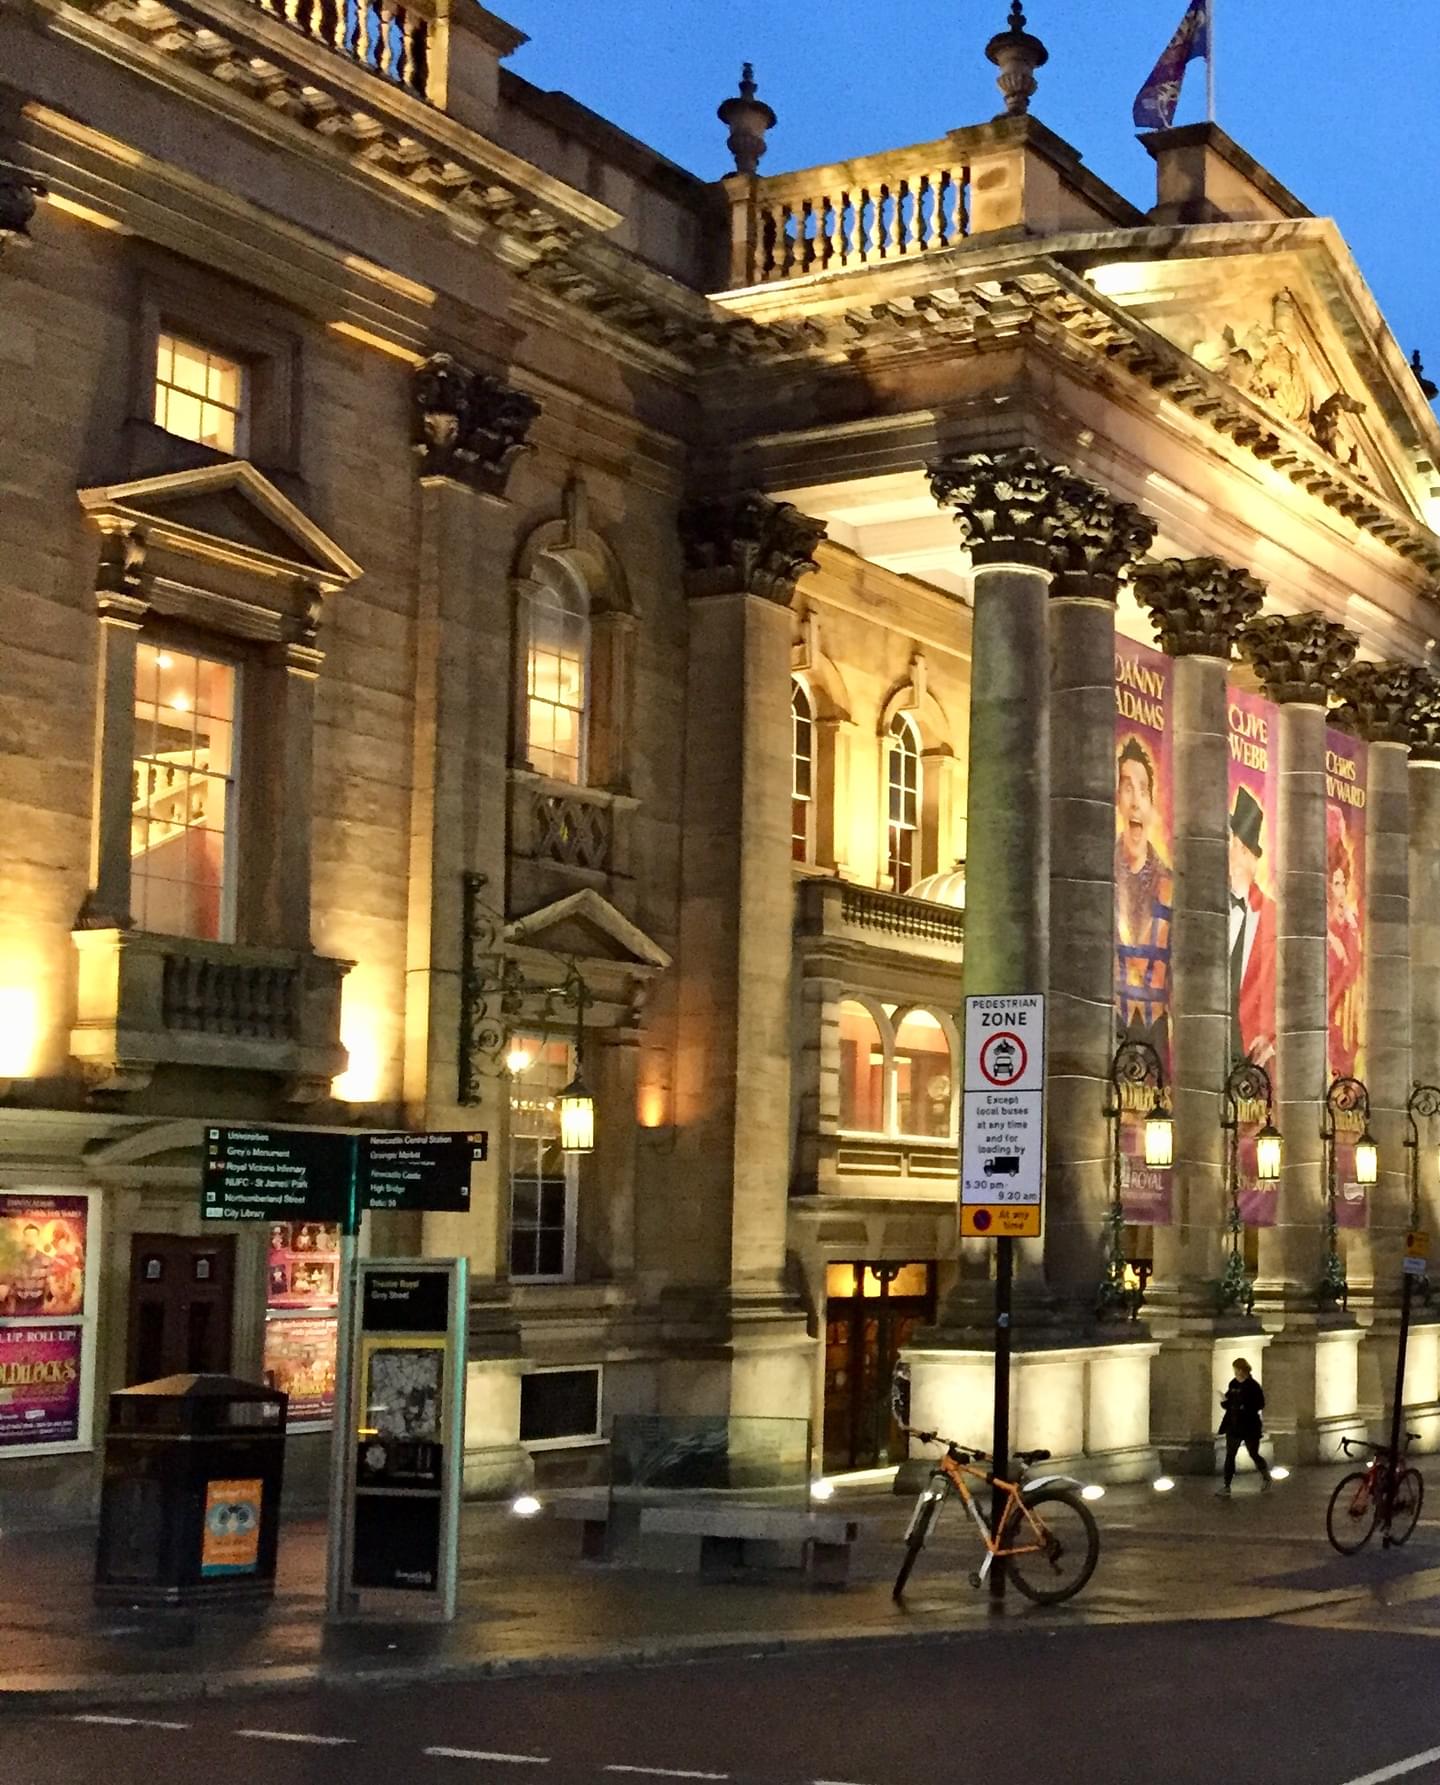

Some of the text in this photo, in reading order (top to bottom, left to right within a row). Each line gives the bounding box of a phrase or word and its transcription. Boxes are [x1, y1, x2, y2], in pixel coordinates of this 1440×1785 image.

[1115, 653, 1165, 700] DANNY
[1115, 686, 1165, 731] ADAMS
[1228, 703, 1268, 744] CLIVE
[1227, 732, 1268, 773] WEBB
[972, 999, 1037, 1009] PEDESTRIAN
[981, 1012, 1027, 1027] ZONE
[986, 1096, 1019, 1105] Except
[976, 1107, 1029, 1116] local buses
[977, 1120, 1028, 1130] at any time
[370, 1135, 452, 1145] Newcastle Central Station
[985, 1135, 1018, 1143] and for
[252, 1148, 290, 1158] Monument
[978, 1145, 1026, 1155] loading by
[226, 1161, 307, 1175] Royal Victoria Infirmary
[225, 1178, 249, 1187] NUFC
[291, 1179, 308, 1189] Park
[1130, 1171, 1165, 1190] ROYAL
[370, 1183, 406, 1195] High Bridge
[224, 1193, 306, 1204] Northumberland Street
[224, 1208, 265, 1219] City Library
[7, 1332, 23, 1342] UP
[27, 1331, 55, 1342] ROLL
[0, 1360, 76, 1384] LDILOCKS
